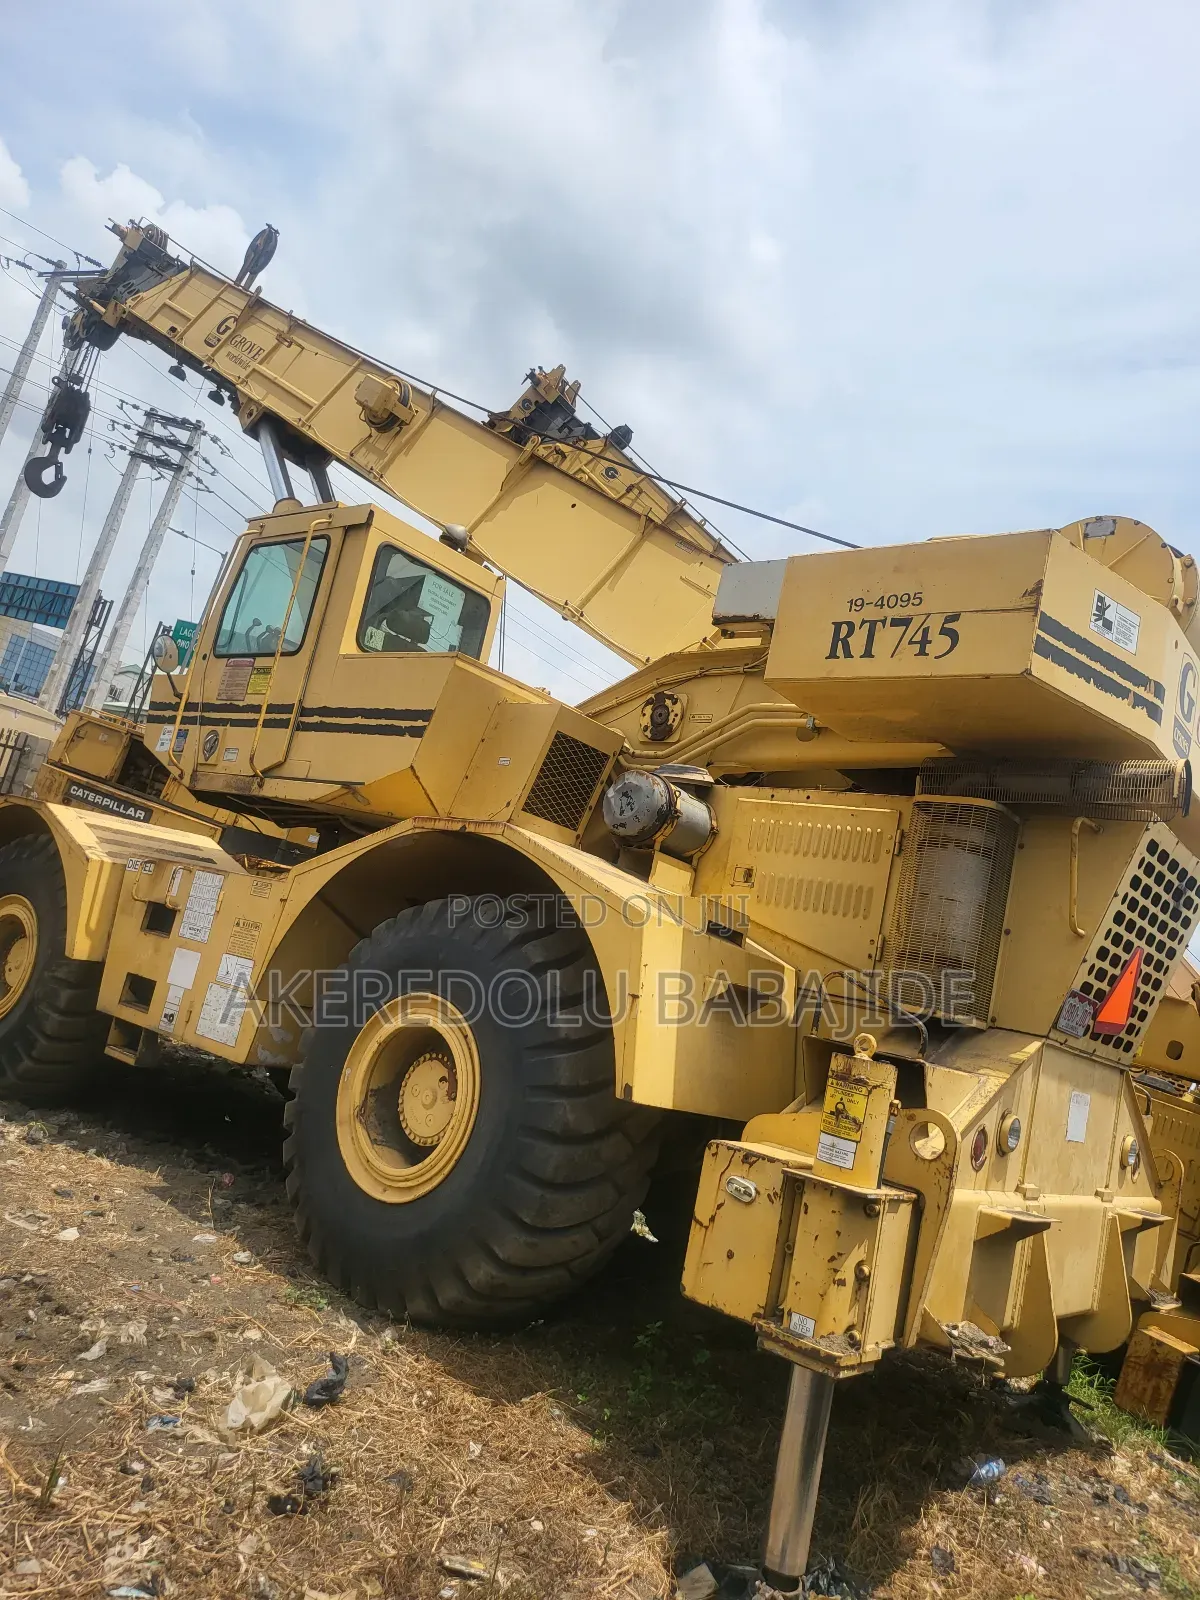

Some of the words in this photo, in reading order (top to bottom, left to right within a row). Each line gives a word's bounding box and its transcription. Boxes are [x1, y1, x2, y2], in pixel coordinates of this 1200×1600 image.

[229, 333, 266, 361] GROVE
[846, 591, 923, 612] 19-4095
[824, 613, 962, 660] RT745
[1179, 661, 1196, 724] G
[70, 785, 145, 820] CATERPILLAR
[127, 858, 153, 874] DIEEL
[792, 1321, 811, 1335] STEP
[797, 1315, 808, 1326] NO
